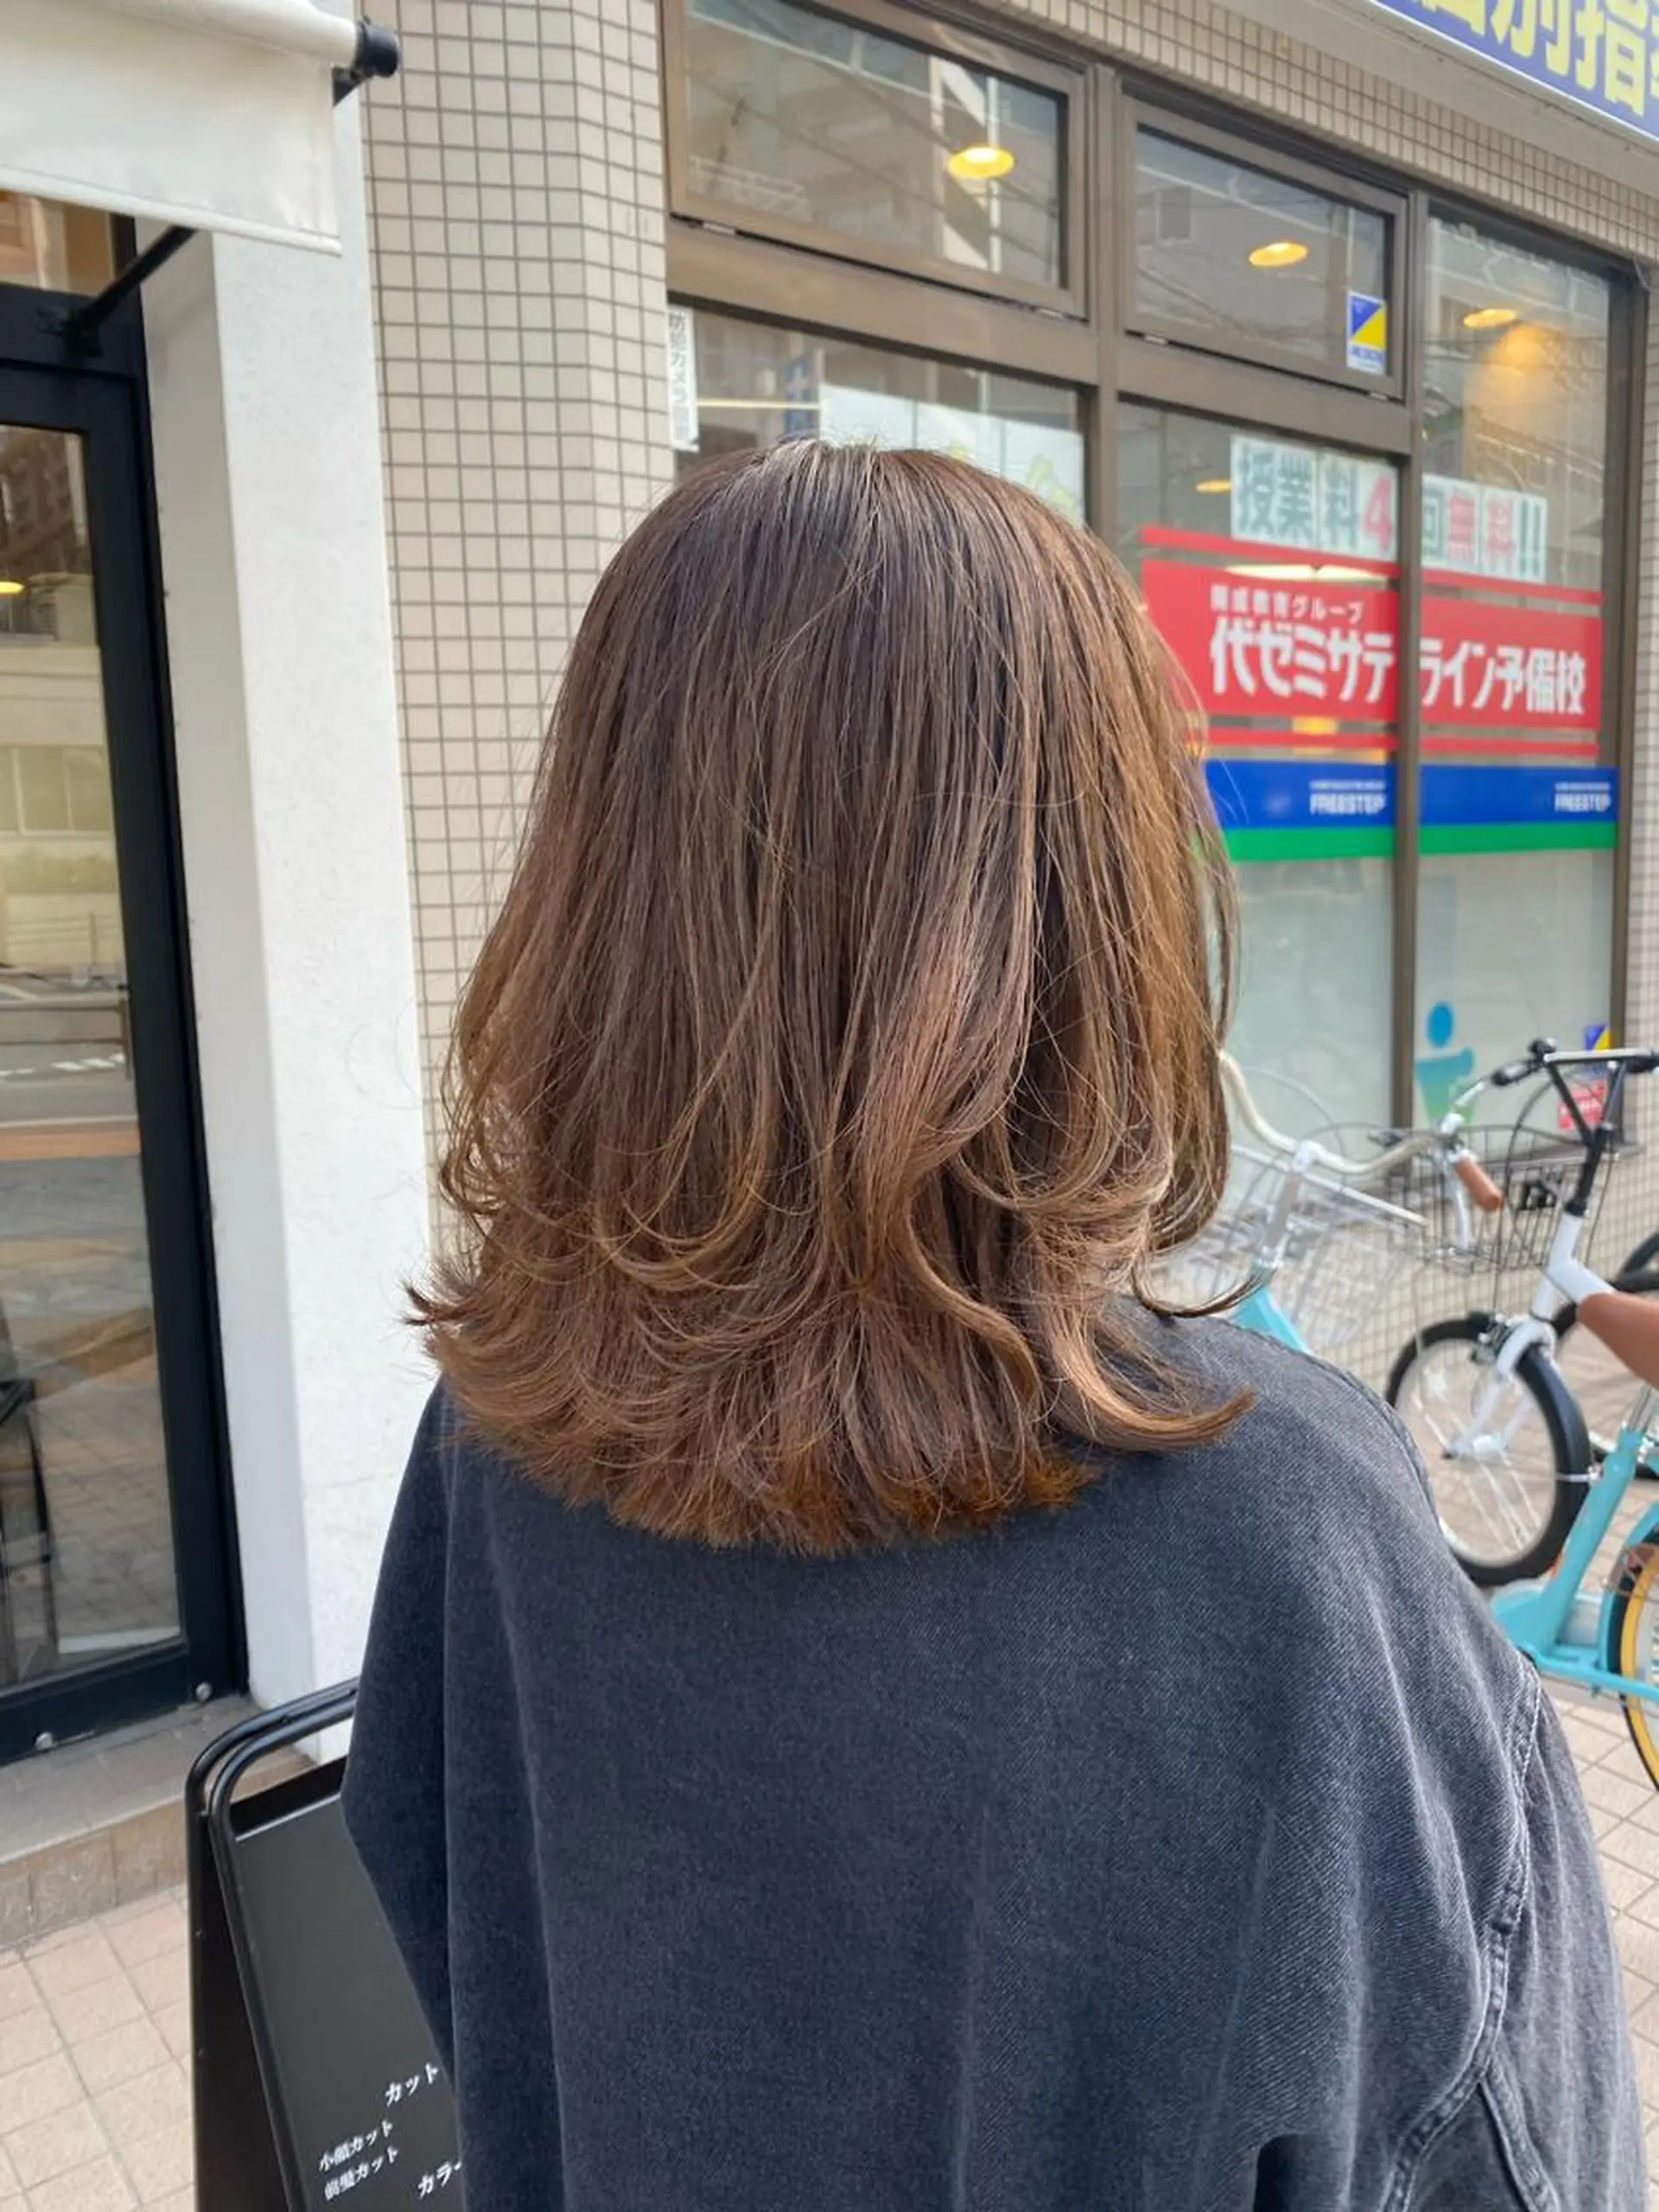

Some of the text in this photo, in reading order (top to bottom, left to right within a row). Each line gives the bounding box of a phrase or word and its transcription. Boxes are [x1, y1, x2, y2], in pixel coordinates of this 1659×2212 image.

[1412, 0, 1659, 117] 別指
[669, 310, 690, 442] 防犯カメラ
[385, 2062, 439, 2107] カット
